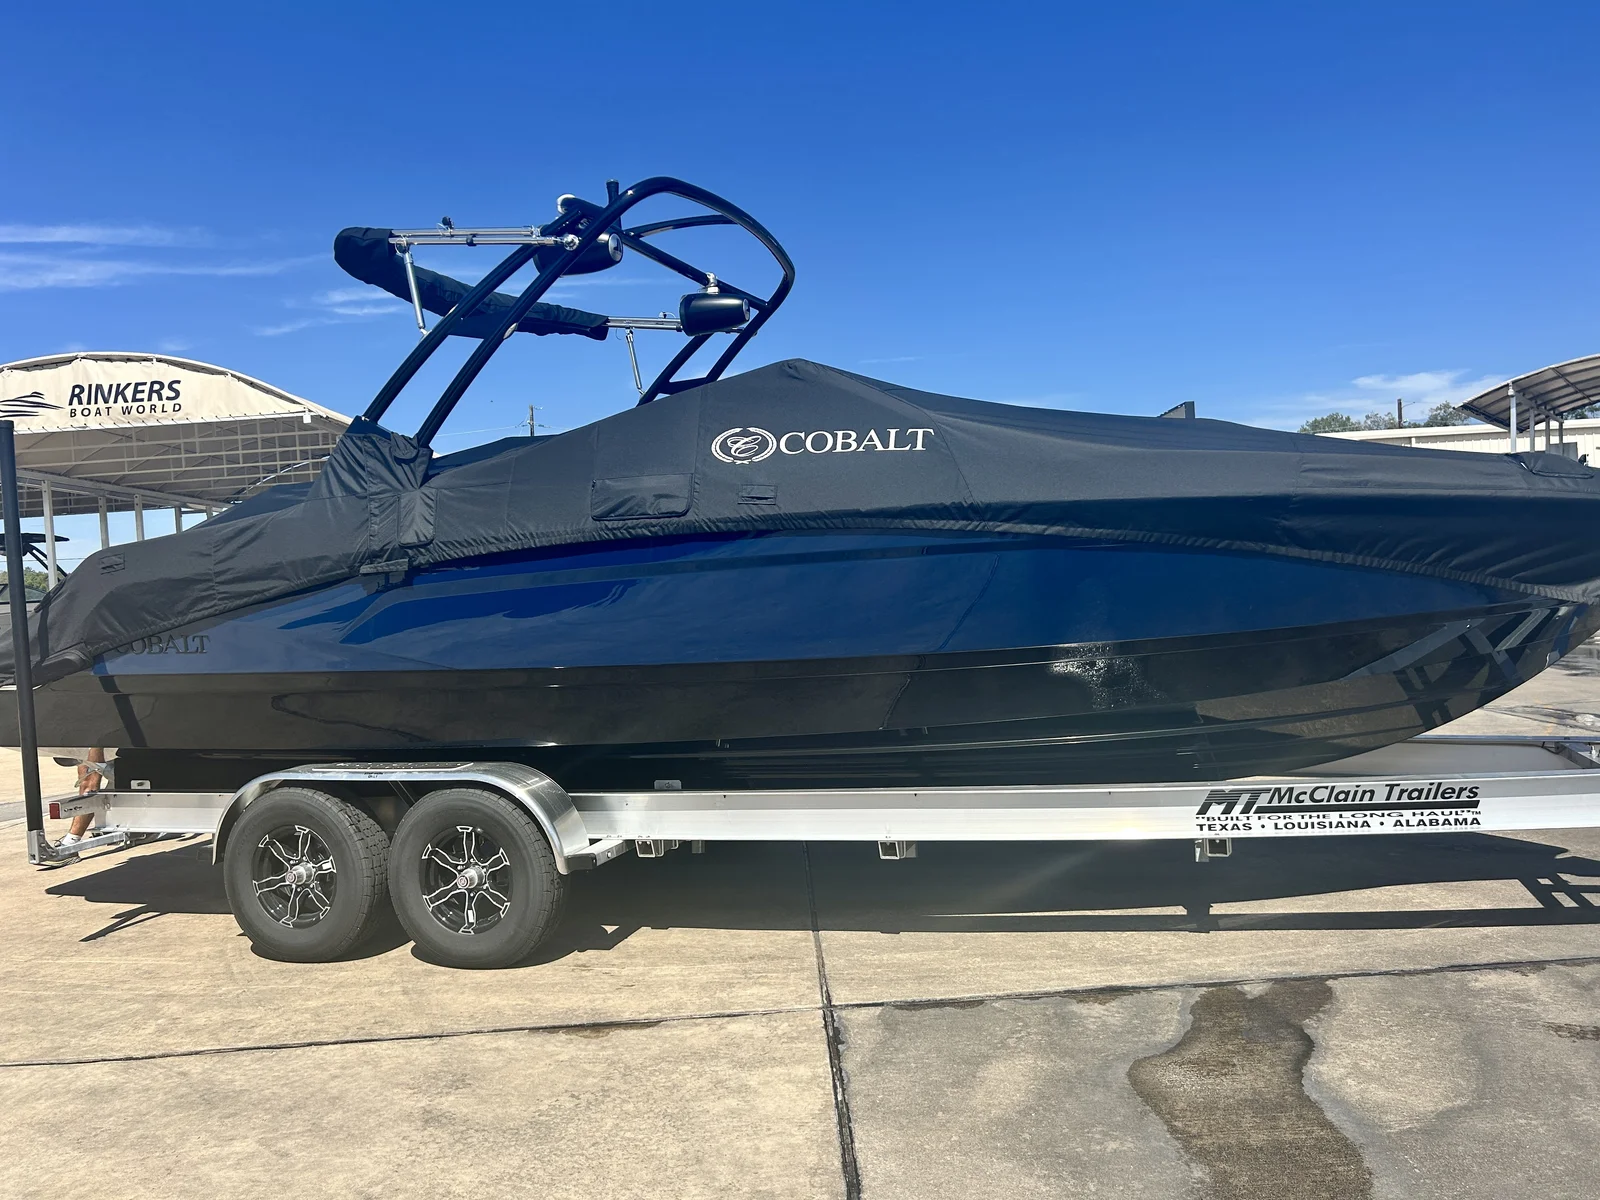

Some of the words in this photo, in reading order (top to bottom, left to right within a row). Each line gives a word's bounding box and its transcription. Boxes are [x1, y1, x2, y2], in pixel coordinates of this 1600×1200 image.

[68, 380, 181, 406] RINKERS
[69, 406, 112, 418] BOAT
[121, 403, 182, 416] WORLD
[779, 428, 935, 455] COBALT
[1266, 785, 1376, 805] McClain
[1384, 782, 1480, 801] Trailers
[1196, 822, 1253, 832] TEXAS
[1273, 820, 1372, 830] LOUISIANA
[1392, 817, 1481, 828] ALABAMA
[1338, 811, 1404, 819] LONG
